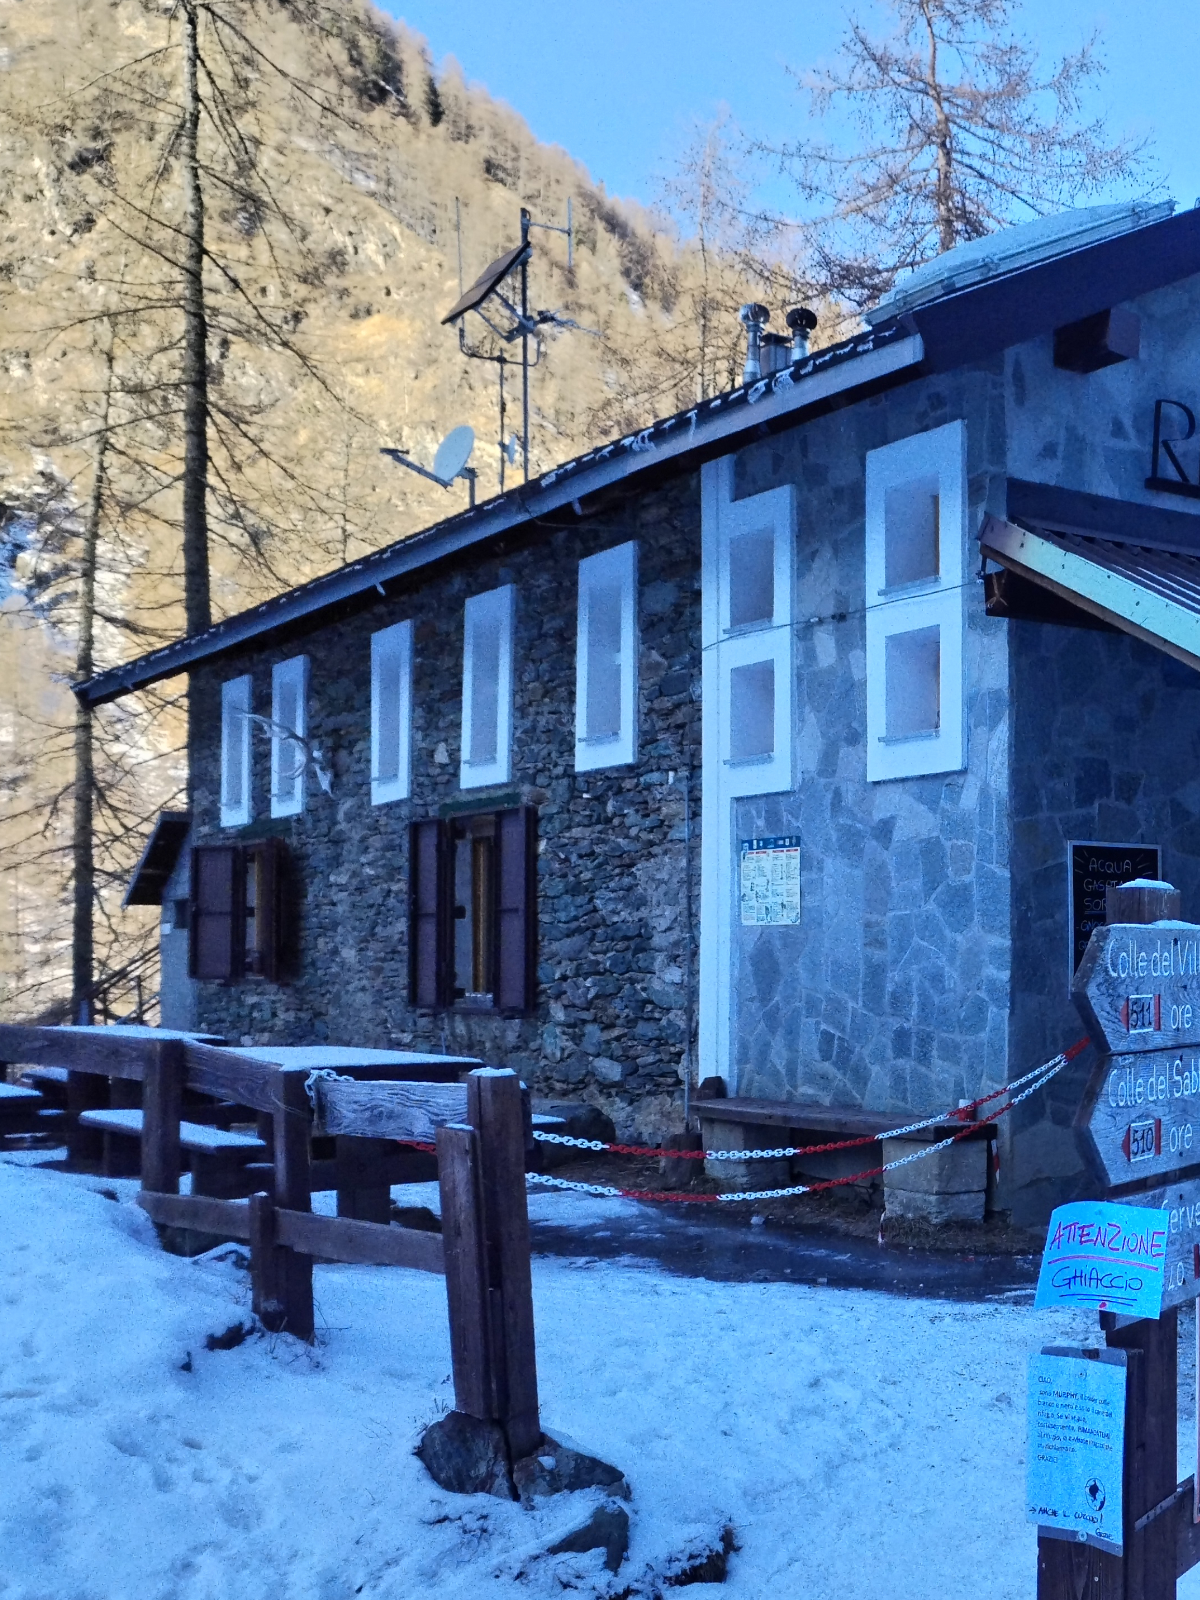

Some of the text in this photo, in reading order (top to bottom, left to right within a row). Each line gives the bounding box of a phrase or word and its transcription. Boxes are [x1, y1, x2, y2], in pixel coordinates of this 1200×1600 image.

[1089, 858, 1132, 874] ACQUA
[1108, 939, 1147, 978] Colle
[1151, 940, 1175, 977] del
[1129, 1000, 1153, 1028] 511
[1170, 1003, 1192, 1028] ore
[1108, 1066, 1144, 1108] Colle
[1149, 1061, 1170, 1100] del
[1131, 1126, 1153, 1156] 510
[1169, 1128, 1192, 1153] ore
[1049, 1221, 1166, 1258] ATTENZIONE
